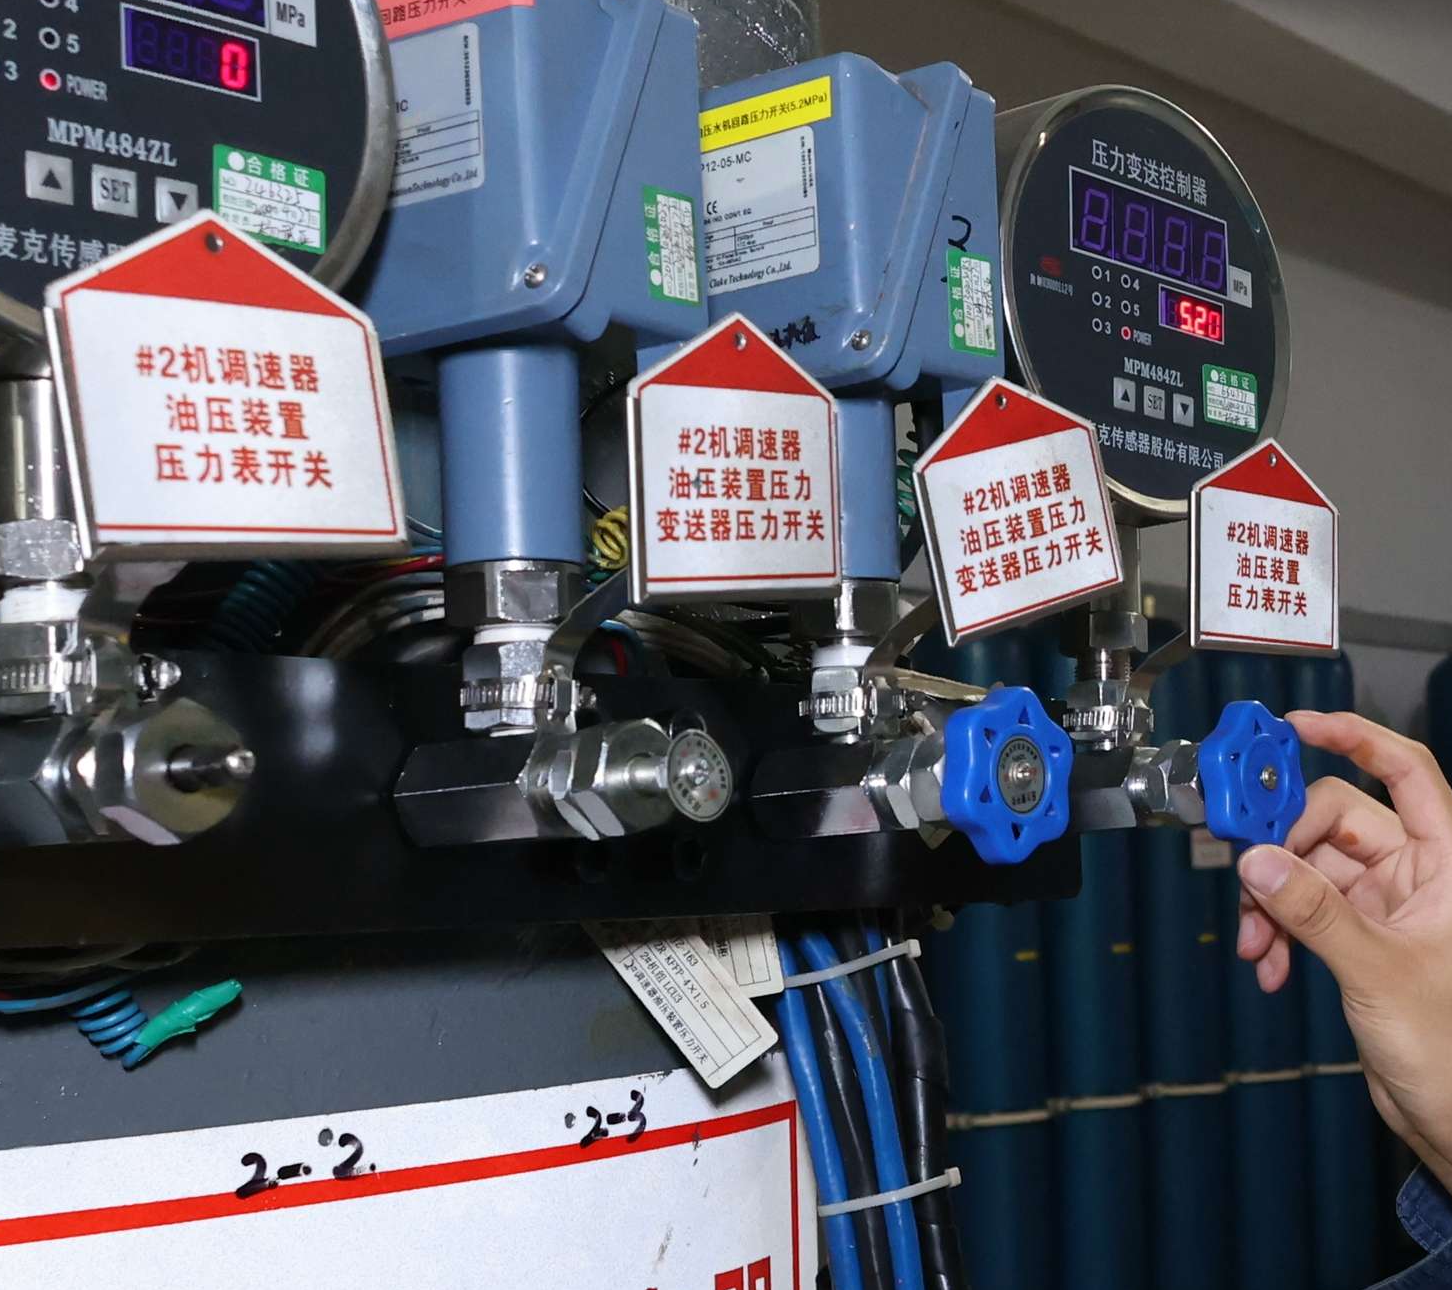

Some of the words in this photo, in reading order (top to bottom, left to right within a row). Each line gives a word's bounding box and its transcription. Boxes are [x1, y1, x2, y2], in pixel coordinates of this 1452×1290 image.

[0, 14, 18, 40] 2
[65, 33, 81, 56] 5
[1, 58, 19, 82] 3
[65, 72, 109, 103] POWER
[45, 115, 177, 169] MPM484ZL
[247, 155, 311, 188] 合格证
[1091, 138, 1208, 206] 压力变送控制器
[98, 178, 135, 207] SET
[643, 203, 661, 267] 合格证
[729, 267, 765, 284] Technology
[950, 265, 964, 321] 合格证
[1104, 269, 1111, 282] 1
[1132, 278, 1140, 292] 4
[1232, 278, 1248, 297] MPa
[1103, 296, 1112, 309] 2
[1132, 304, 1140, 317] 5
[1103, 321, 1112, 335] 3
[1132, 328, 1153, 346] POWER
[134, 342, 321, 394] #2机调速器
[1123, 356, 1184, 388] MPM484ZL
[1219, 371, 1250, 390] 合格证
[164, 393, 307, 442] 油压装置
[1147, 393, 1164, 412] SET
[677, 426, 803, 463] #2机调速器
[1089, 421, 1225, 470] 克传感器股份有限公司
[154, 442, 334, 490] 压力表开关
[668, 466, 813, 503] 油压装置压力
[961, 462, 1074, 518] #2机调速器
[655, 507, 826, 544] 变送器压力开关
[959, 496, 1088, 557] 油压装置压力
[1226, 520, 1311, 557] #2机调速器
[954, 527, 1105, 598] 变送器压力开关
[1236, 555, 1301, 587] 油压装置
[1226, 582, 1309, 618] 压力表开关
